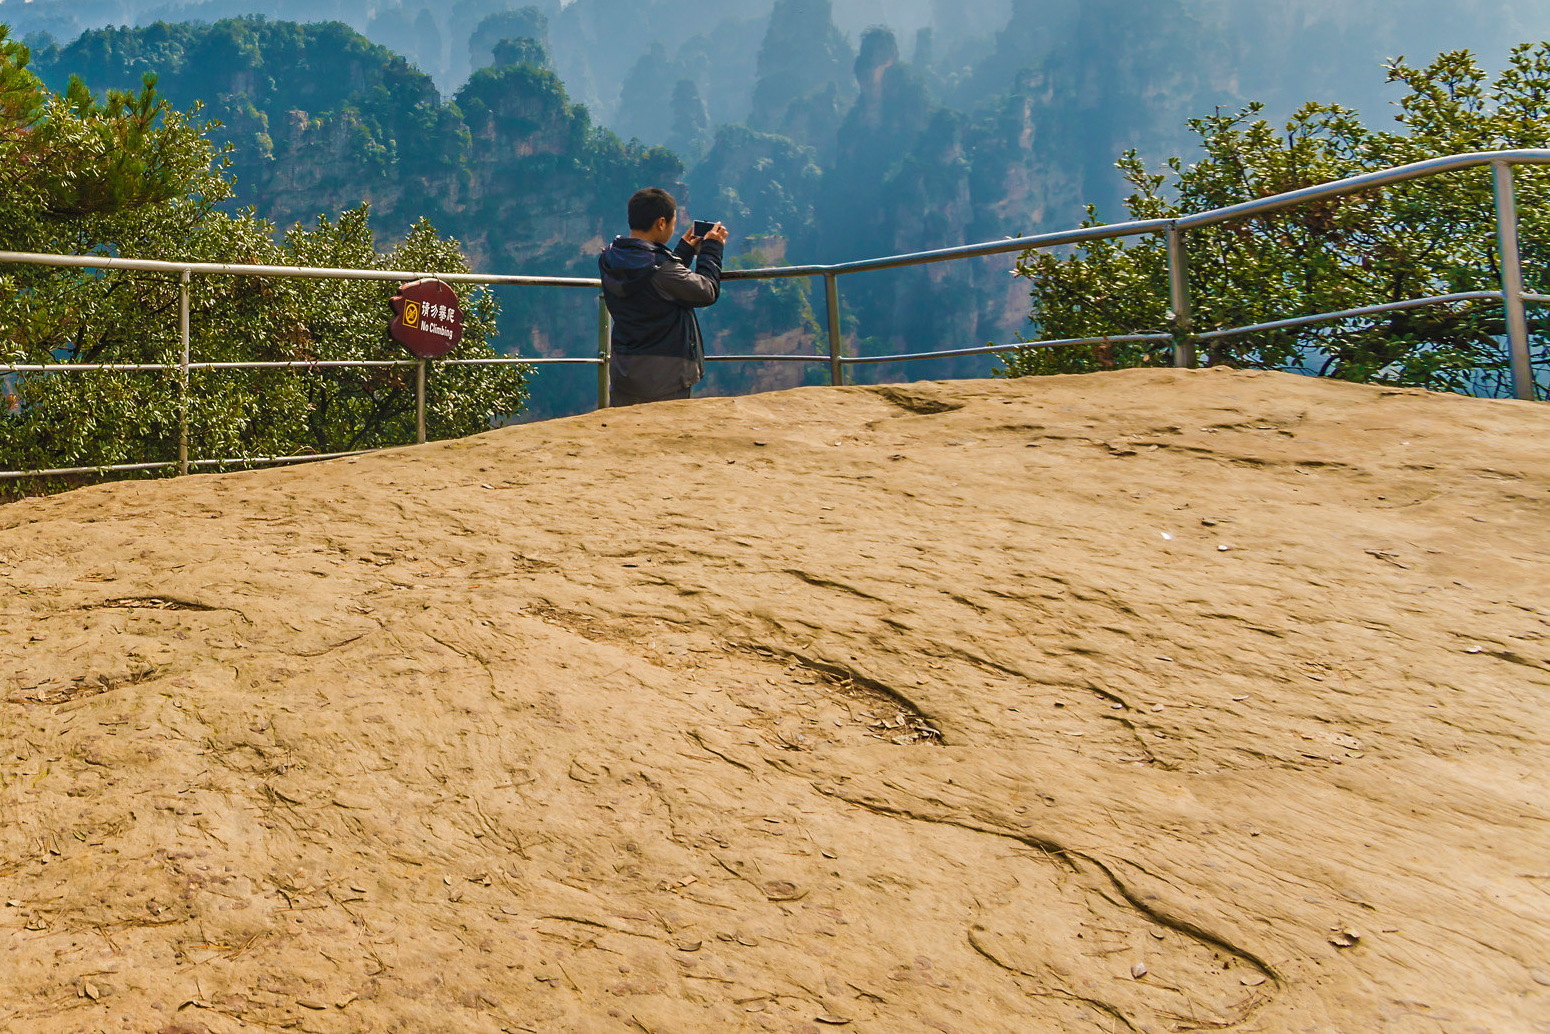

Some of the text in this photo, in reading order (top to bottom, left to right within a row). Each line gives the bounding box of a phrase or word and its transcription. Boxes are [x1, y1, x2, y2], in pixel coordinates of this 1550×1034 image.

[422, 301, 455, 323] 请勿攀爬
[420, 320, 453, 340] No Climbing
